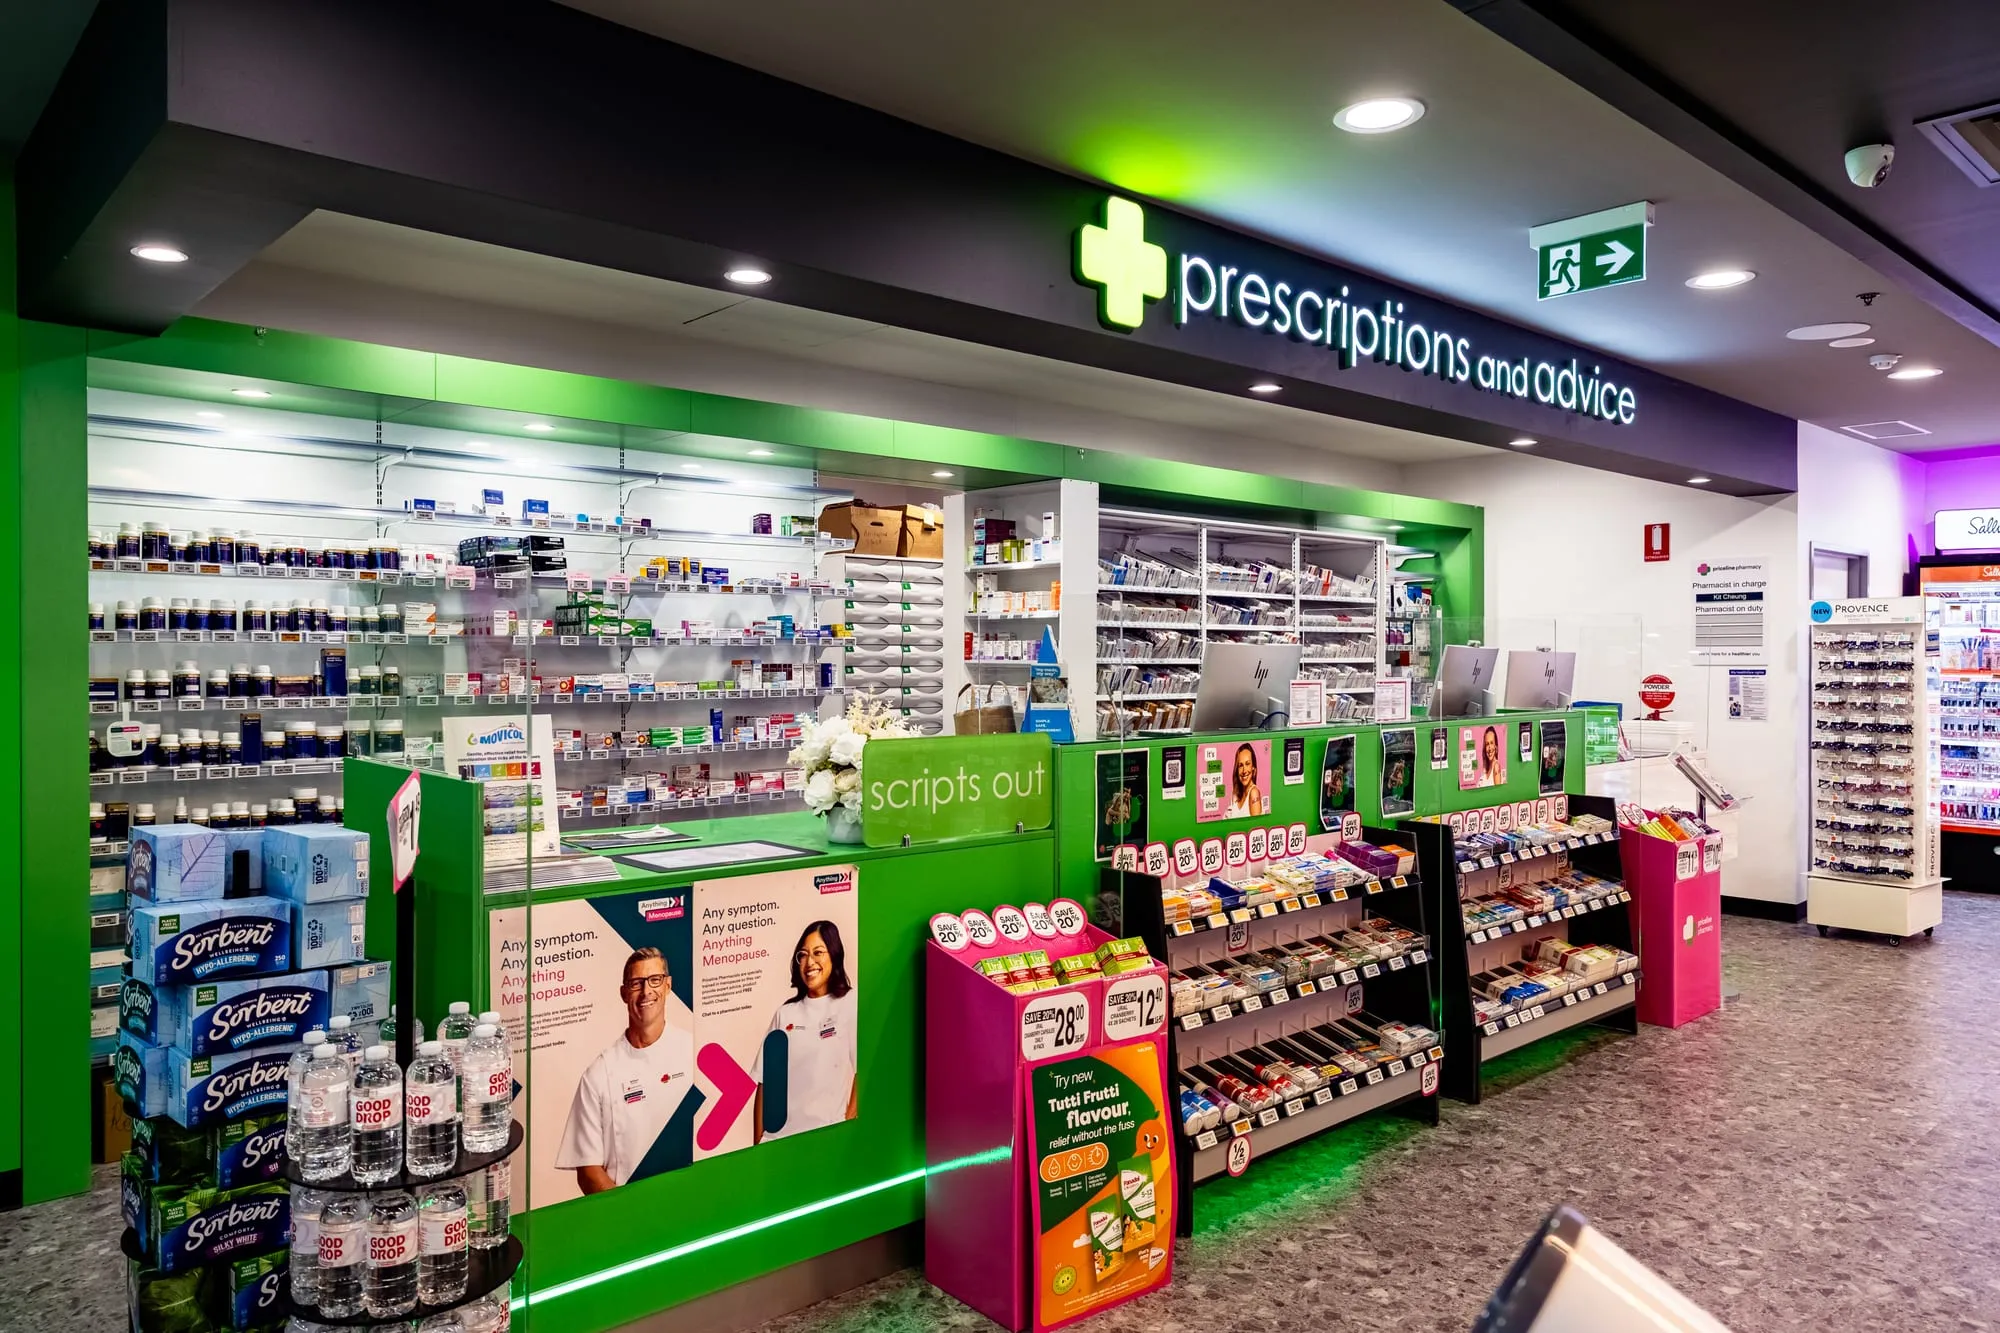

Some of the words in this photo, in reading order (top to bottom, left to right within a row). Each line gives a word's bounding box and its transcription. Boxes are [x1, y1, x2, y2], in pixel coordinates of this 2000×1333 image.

[1180, 252, 1470, 381] prescriptions
[1477, 357, 1528, 398] and
[1535, 357, 1636, 424] advice
[1692, 581, 1731, 589] Pharmacist
[1742, 580, 1766, 588] charge
[1835, 604, 1889, 613] PROVENCE
[1253, 660, 1269, 689] hp
[480, 729, 524, 745] MOVICOL
[1212, 776, 1221, 784] get
[870, 766, 981, 814] scripts
[993, 761, 1045, 799] out
[1202, 789, 1214, 797] your
[1205, 801, 1217, 809] shot
[1271, 833, 1283, 841] SAVE
[1344, 825, 1358, 836] 30%
[1231, 840, 1242, 848] SAVE
[1252, 841, 1265, 853] 20%
[1270, 839, 1284, 852] 20%
[1290, 836, 1303, 848] 20%
[1150, 850, 1163, 860] SAVE
[1179, 846, 1192, 855] SAVE
[1205, 846, 1218, 854] SAVE
[1229, 845, 1244, 858] 20%
[1150, 858, 1166, 871] 20%
[1179, 853, 1194, 866] 20%
[1205, 851, 1220, 865] 20%
[816, 874, 839, 883] Anything
[820, 884, 850, 893] Menopause
[641, 899, 667, 909] Anything
[702, 908, 725, 920] Any
[727, 901, 780, 918] symptom.
[648, 908, 682, 919] Menopause
[999, 914, 1019, 923] SAVE
[1054, 907, 1074, 917] SAVE
[702, 923, 725, 935] Any
[727, 916, 776, 933] question.
[937, 923, 958, 931] SAVE
[968, 919, 987, 927] SAVE
[1001, 921, 1024, 934] 20%
[1057, 914, 1080, 929] 20%
[938, 930, 964, 943] 20%
[970, 926, 993, 938] 20%
[1231, 929, 1245, 942] 20%
[171, 922, 274, 970] Sorbent
[500, 940, 527, 953] Any
[534, 930, 598, 950] symptom.
[702, 935, 752, 951] Anything
[1112, 942, 1131, 953] Ural
[209, 947, 244, 958] WELLBEING
[702, 948, 770, 967] Menopause.
[1031, 954, 1046, 964] Ural
[195, 955, 256, 975] HYPO-ALLERGENIC
[500, 958, 527, 971] Any
[534, 948, 594, 967] question.
[1009, 957, 1024, 967] Ural
[1064, 957, 1083, 970] Ural
[987, 962, 1002, 971] Ural
[501, 969, 565, 988] Anything
[122, 981, 152, 1017] Sorbent
[1109, 993, 1124, 1006] SAVE
[1125, 991, 1137, 1002] 20%
[208, 992, 312, 1041] Sorbent
[246, 1017, 281, 1029] WELLBEING
[1025, 1011, 1041, 1024] SAVE
[1042, 1009, 1055, 1020] 20%
[233, 1024, 293, 1045] HYPO-ALLERGENIC
[117, 1051, 141, 1085] Sorbent
[1424, 1067, 1436, 1078] SAVE
[1054, 1075, 1069, 1089] Try
[1071, 1070, 1093, 1084] new
[1424, 1074, 1436, 1089] 20%
[241, 1084, 275, 1098] WELLBEING
[1048, 1092, 1081, 1112] Tutti
[1083, 1083, 1119, 1104] Frutti
[227, 1092, 288, 1114] HYPO-ALLERGENIC
[356, 1098, 391, 1112] GOOD
[356, 1110, 391, 1124] DROP
[1066, 1101, 1131, 1129] flavour,
[1049, 1134, 1070, 1149] relief
[1071, 1128, 1102, 1143] without
[1103, 1124, 1117, 1135] the
[1118, 1120, 1135, 1131] fuss
[1231, 1157, 1246, 1169] PRICE
[1123, 1175, 1140, 1186] Panadol
[1141, 1189, 1153, 1198] 5-12
[185, 1198, 280, 1251] Sorbent
[1093, 1214, 1108, 1226] Panadol
[213, 1238, 234, 1253] SILKY
[236, 1233, 258, 1245] WHITE
[370, 1234, 405, 1249] GOOD
[370, 1247, 405, 1260] DROP
